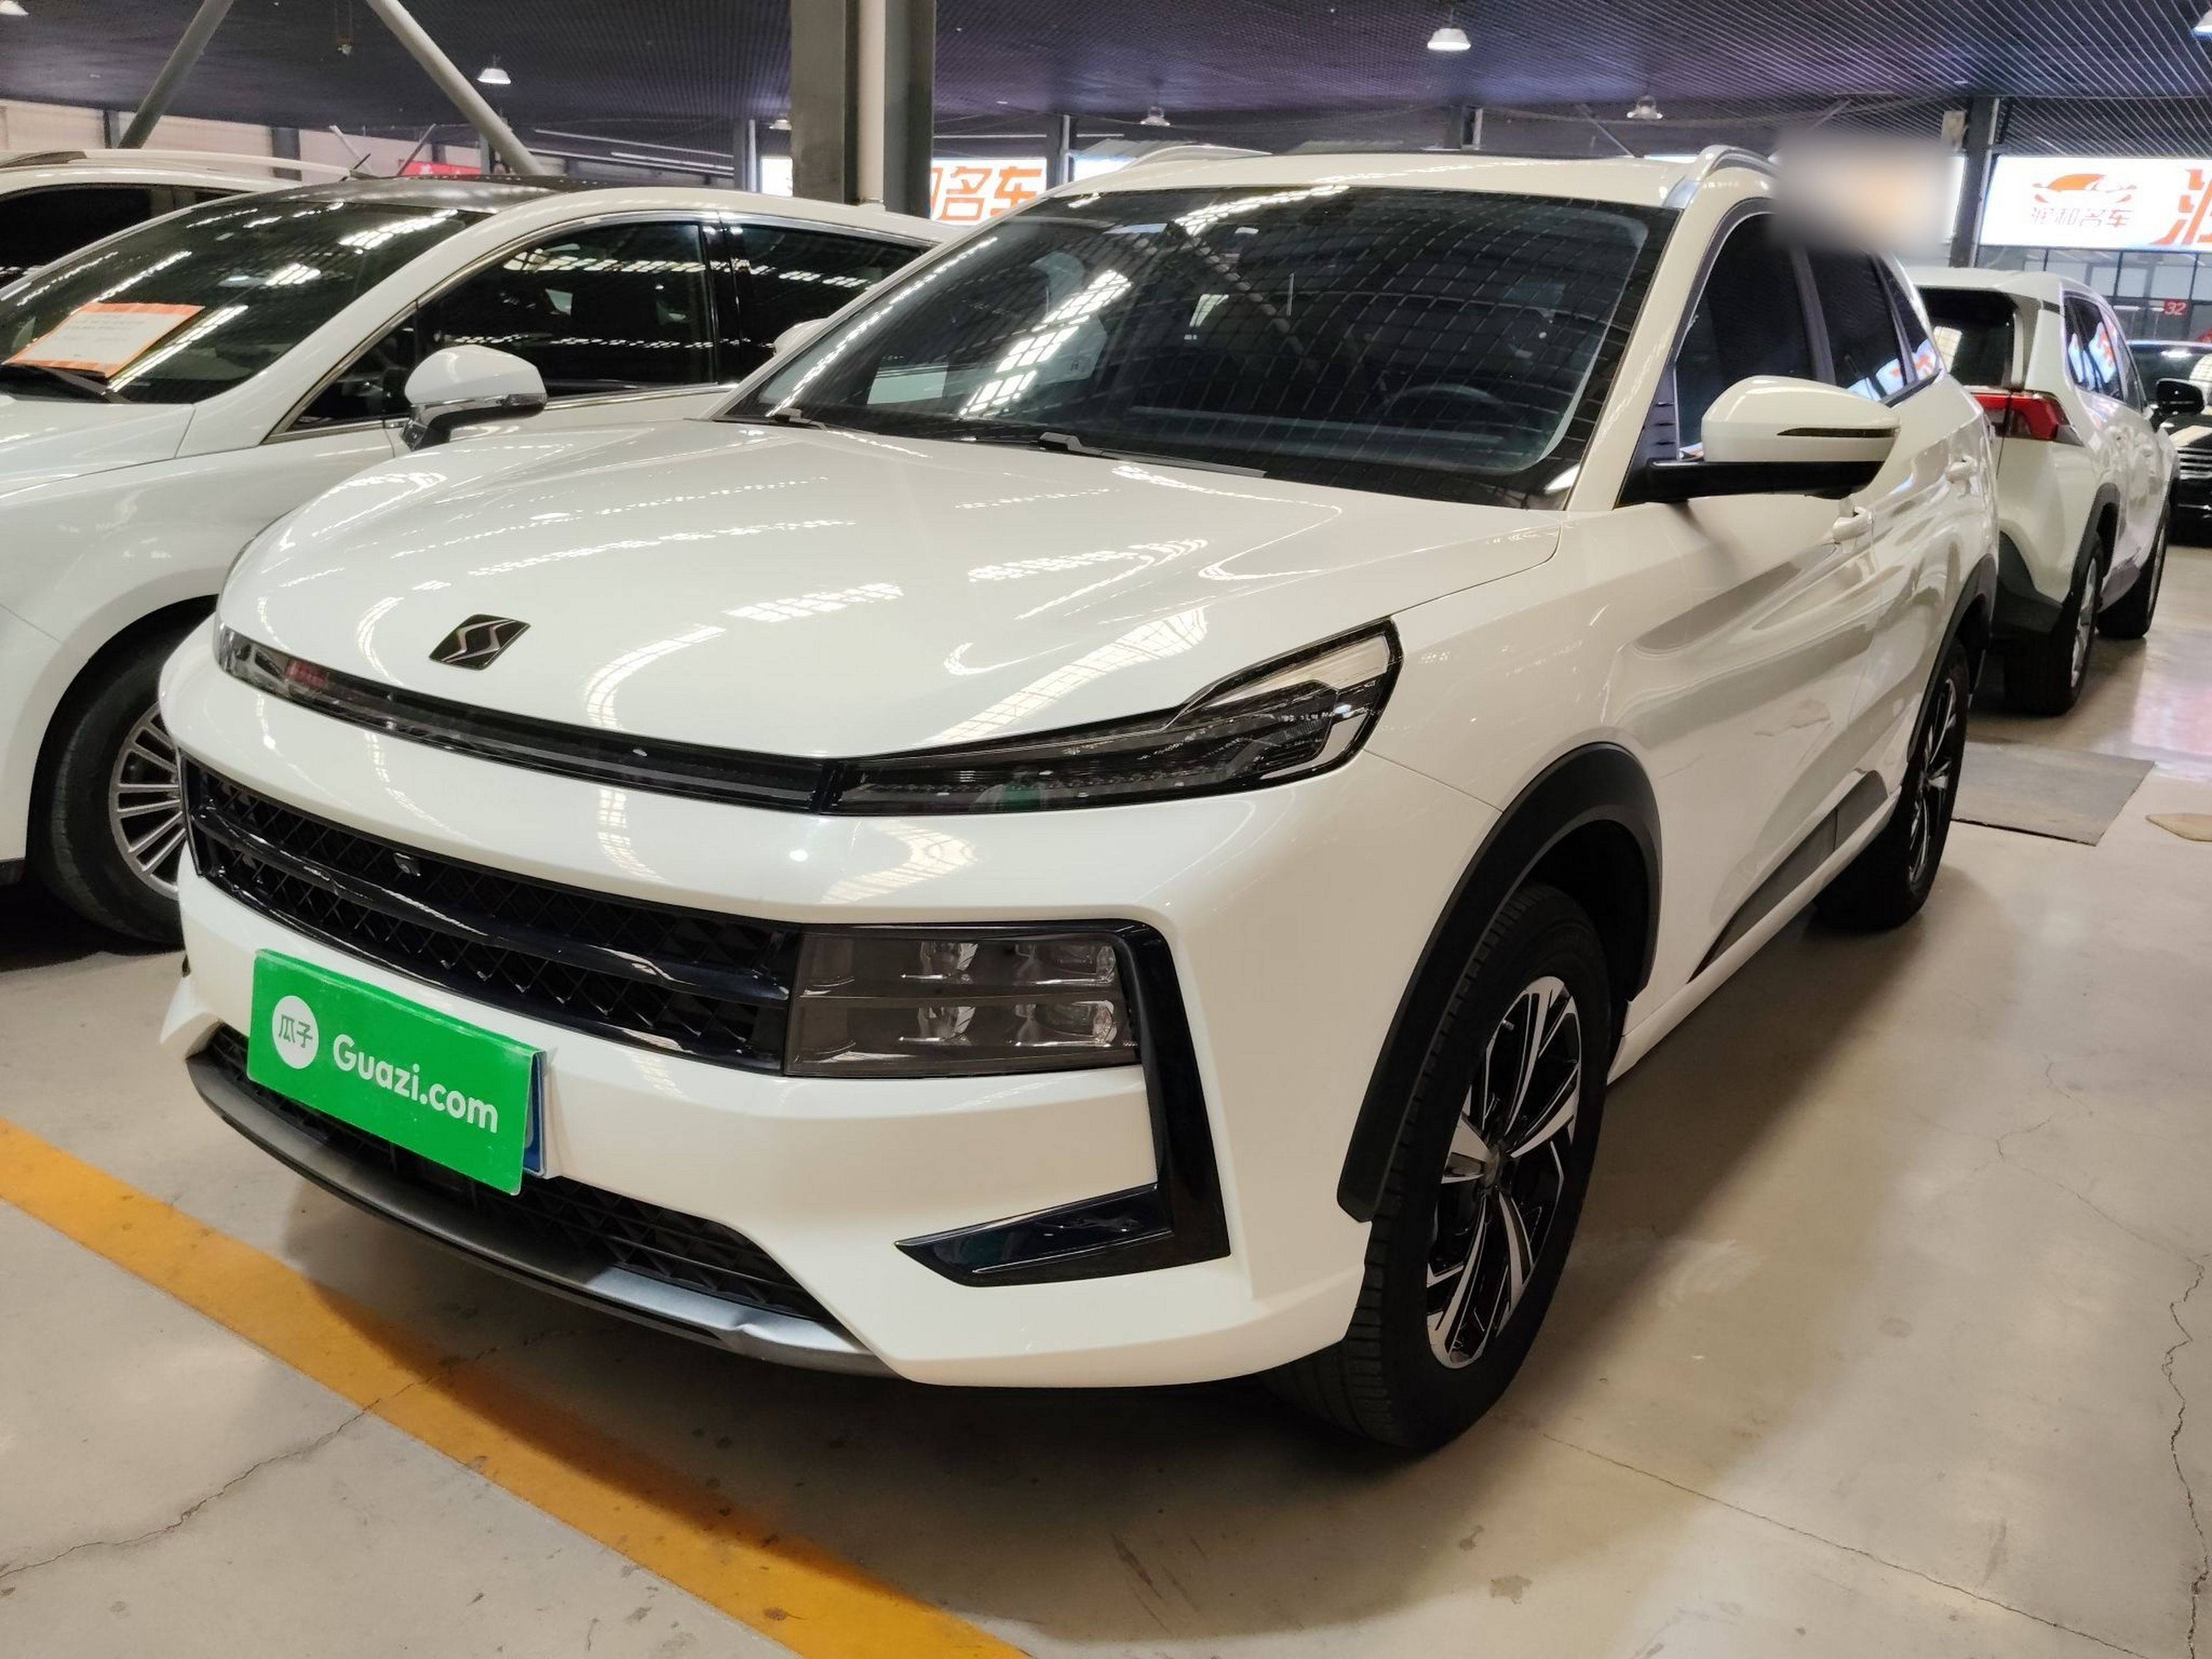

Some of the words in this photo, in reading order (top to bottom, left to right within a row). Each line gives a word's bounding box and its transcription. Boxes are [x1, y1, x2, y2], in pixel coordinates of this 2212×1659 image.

[931, 166, 1042, 221] 名车
[2165, 301, 2187, 316] 32
[278, 1014, 313, 1048] 瓜子
[333, 1034, 498, 1134] Guazi.com
